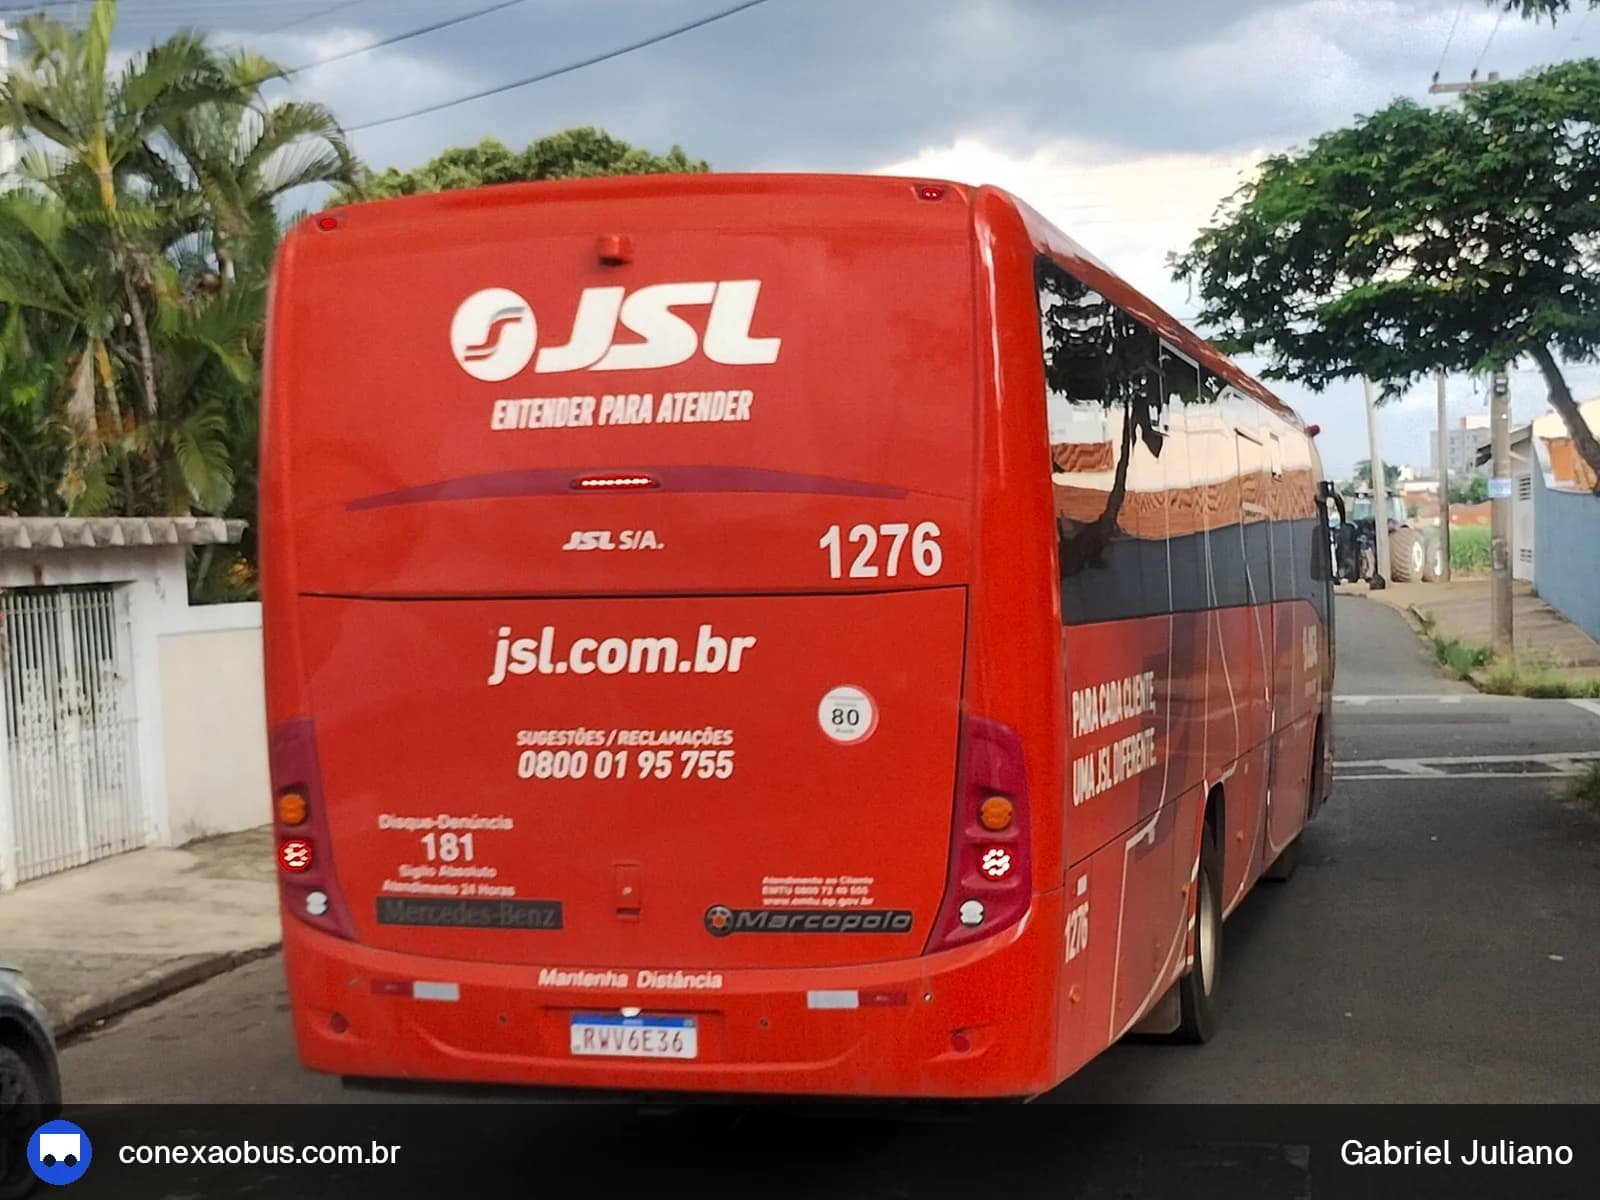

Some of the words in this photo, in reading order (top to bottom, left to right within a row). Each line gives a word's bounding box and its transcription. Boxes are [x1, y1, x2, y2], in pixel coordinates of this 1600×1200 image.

[535, 279, 781, 373] JSL
[491, 396, 595, 430] ENTENDER
[597, 394, 653, 425] PARA
[655, 390, 753, 423] ATENDER
[562, 531, 615, 550] JSL
[619, 530, 665, 551] S/A.
[819, 521, 943, 579] 1276
[487, 624, 757, 686] jsl.com.br
[832, 708, 860, 726] 80
[1072, 686, 1099, 739] PARA
[516, 729, 606, 747] SUGESTÕES
[617, 727, 734, 750] RECLAMAÇÕES
[517, 751, 588, 779] 0800
[593, 751, 627, 778] 01
[637, 751, 672, 778] 95
[680, 751, 734, 778] 755
[421, 833, 474, 861] 181
[385, 901, 555, 926] Mercedes-Benz
[735, 911, 912, 931] Marcopolo
[1065, 901, 1089, 963] 1276
[538, 968, 629, 988] Mantenha
[636, 970, 724, 989] Distância
[583, 1027, 684, 1053] RWV6E36
